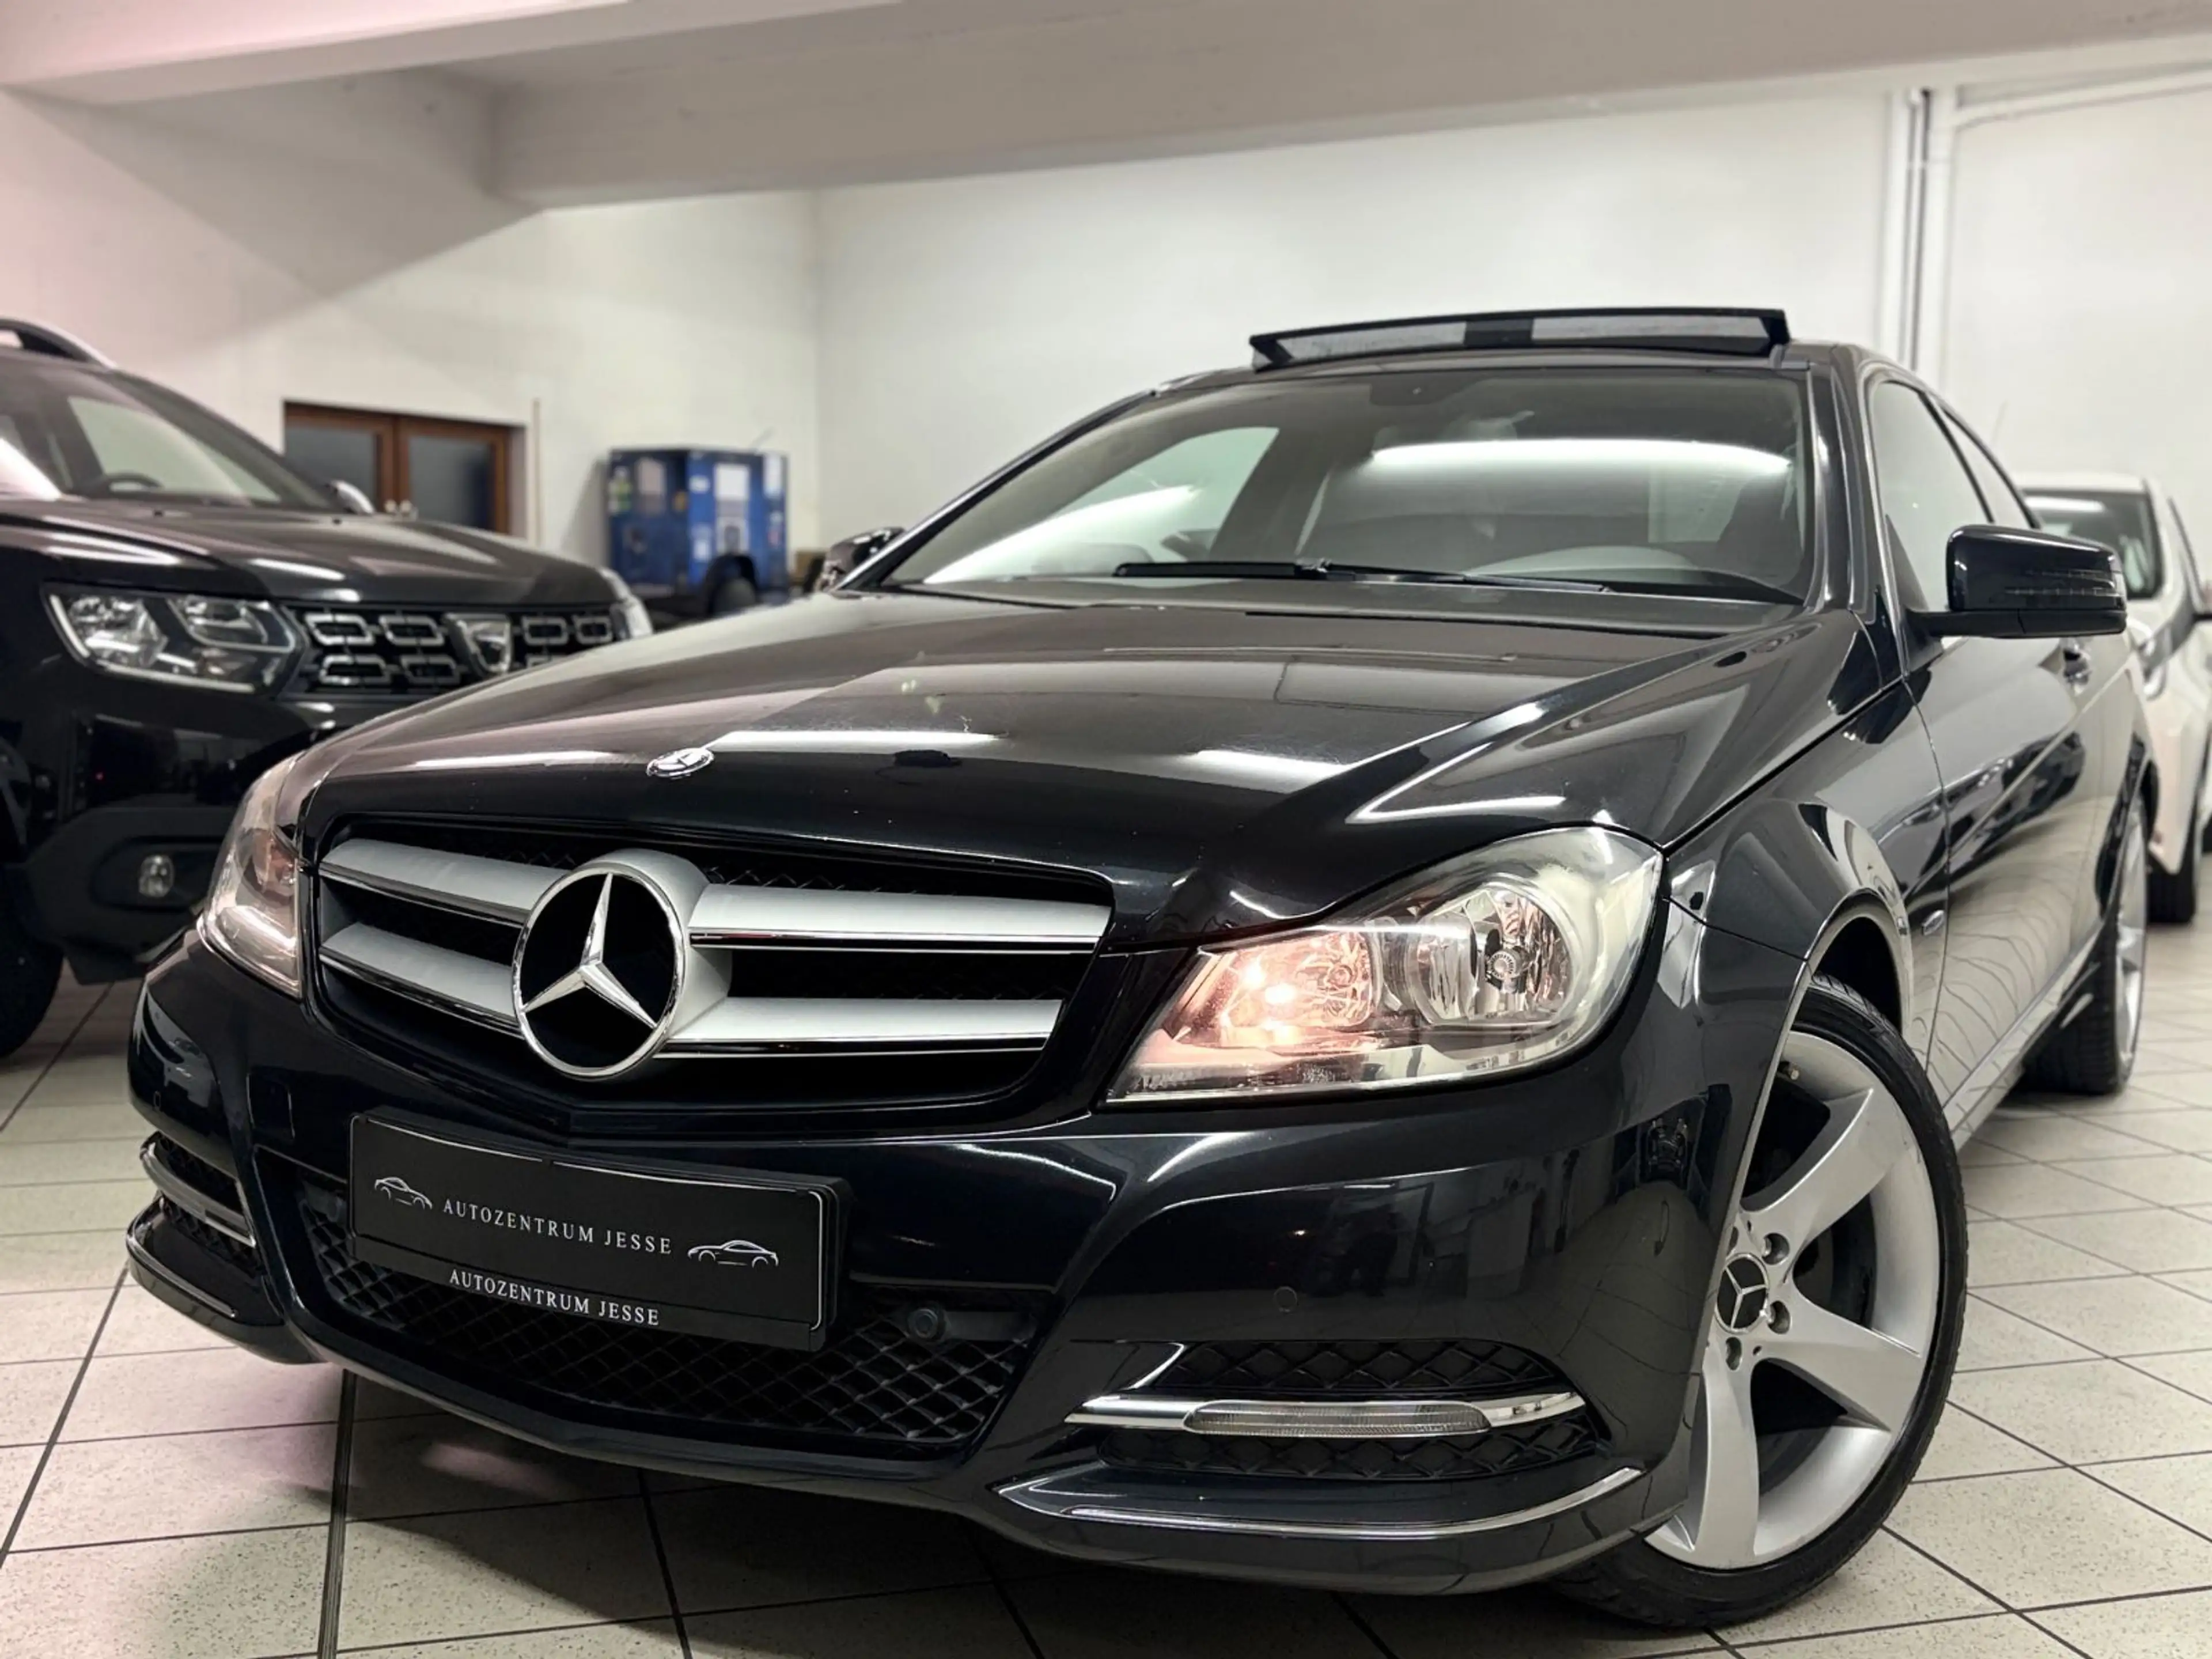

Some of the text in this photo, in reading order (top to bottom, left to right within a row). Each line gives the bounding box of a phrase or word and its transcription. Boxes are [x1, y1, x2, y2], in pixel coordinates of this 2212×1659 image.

[443, 1199, 671, 1254] AUTOZENTRUM JESSE
[449, 1269, 658, 1325] AUTOZENTRUM JESSE
